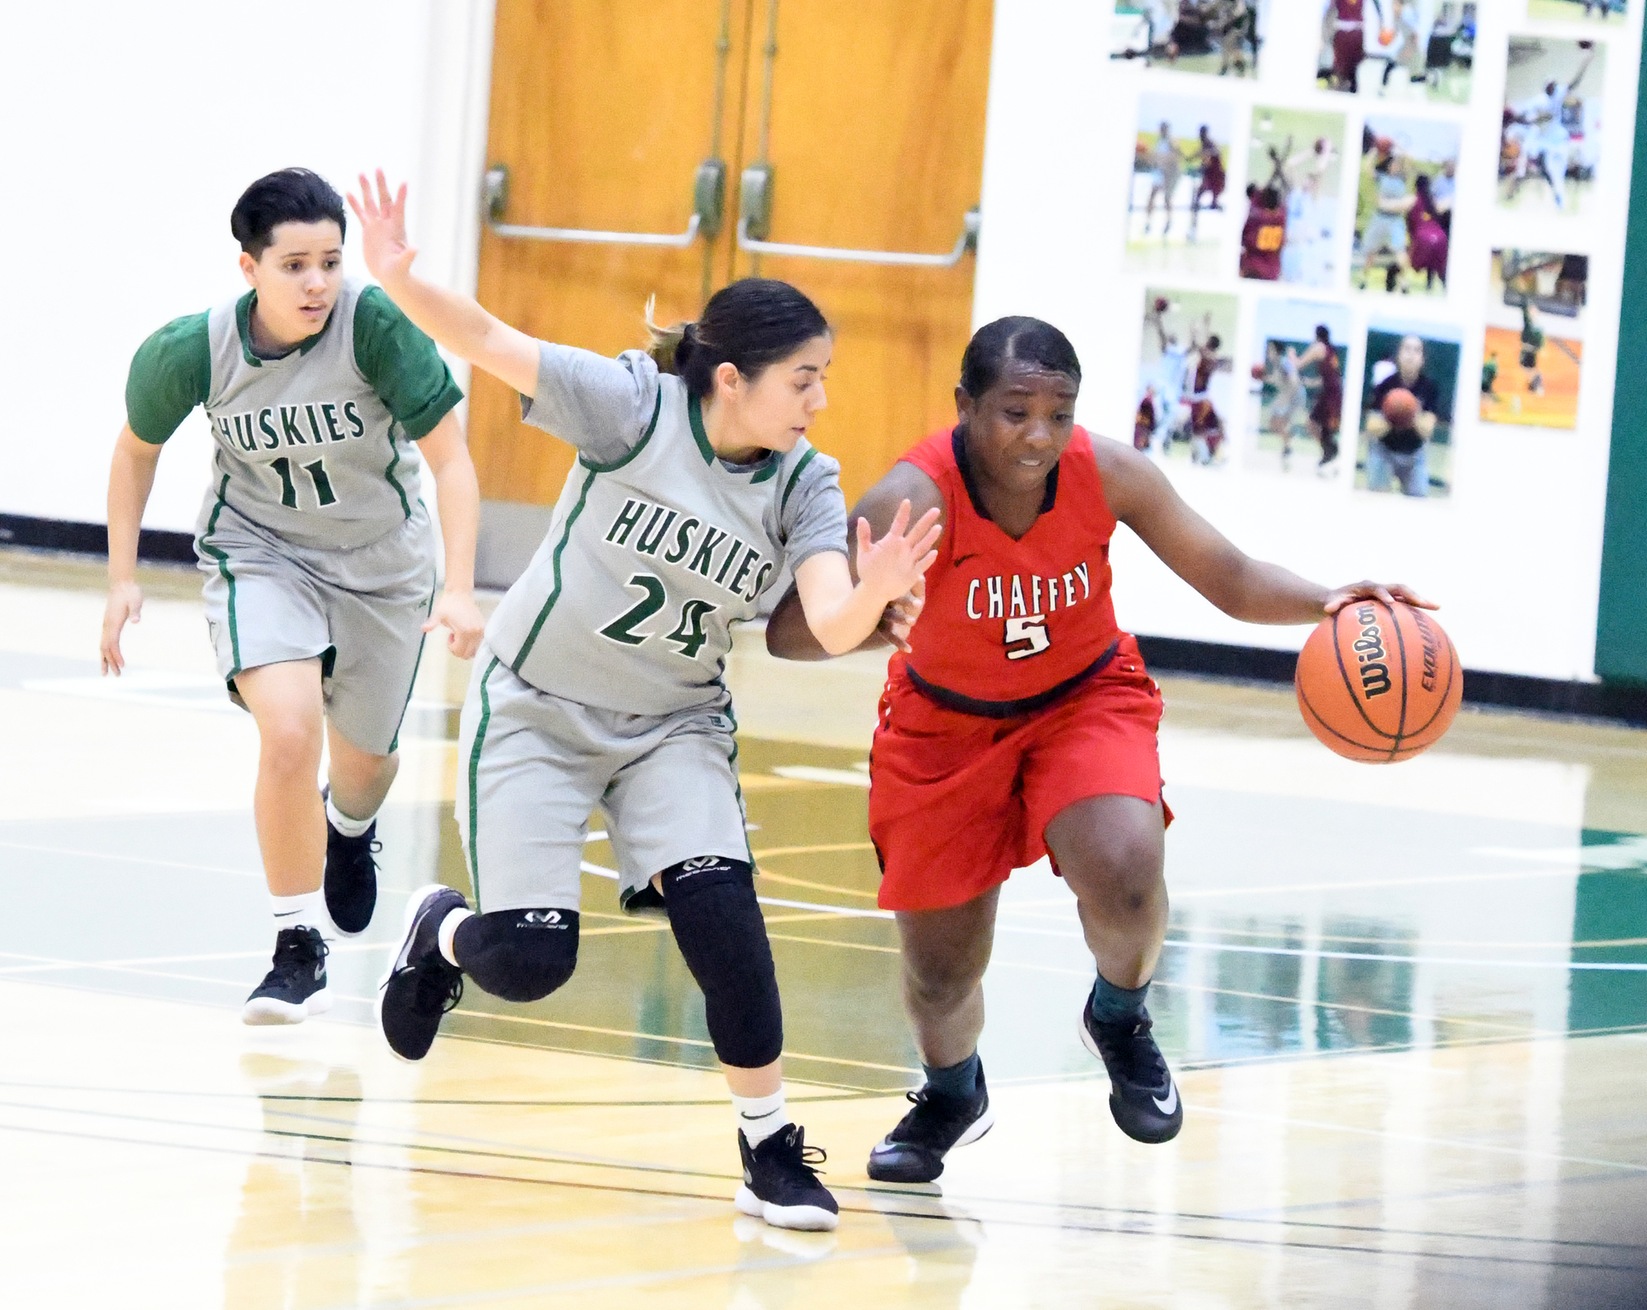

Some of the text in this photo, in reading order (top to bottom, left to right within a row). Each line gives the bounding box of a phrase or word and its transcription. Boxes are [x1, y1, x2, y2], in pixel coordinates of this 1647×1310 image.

[216, 400, 365, 453] HUSKIES
[268, 454, 341, 511] 11
[602, 497, 774, 604] HUSKIES
[594, 572, 722, 660] 24
[966, 561, 1090, 620] CHAFFEY
[1004, 614, 1050, 660] 5
[1353, 602, 1392, 701] Wilson
